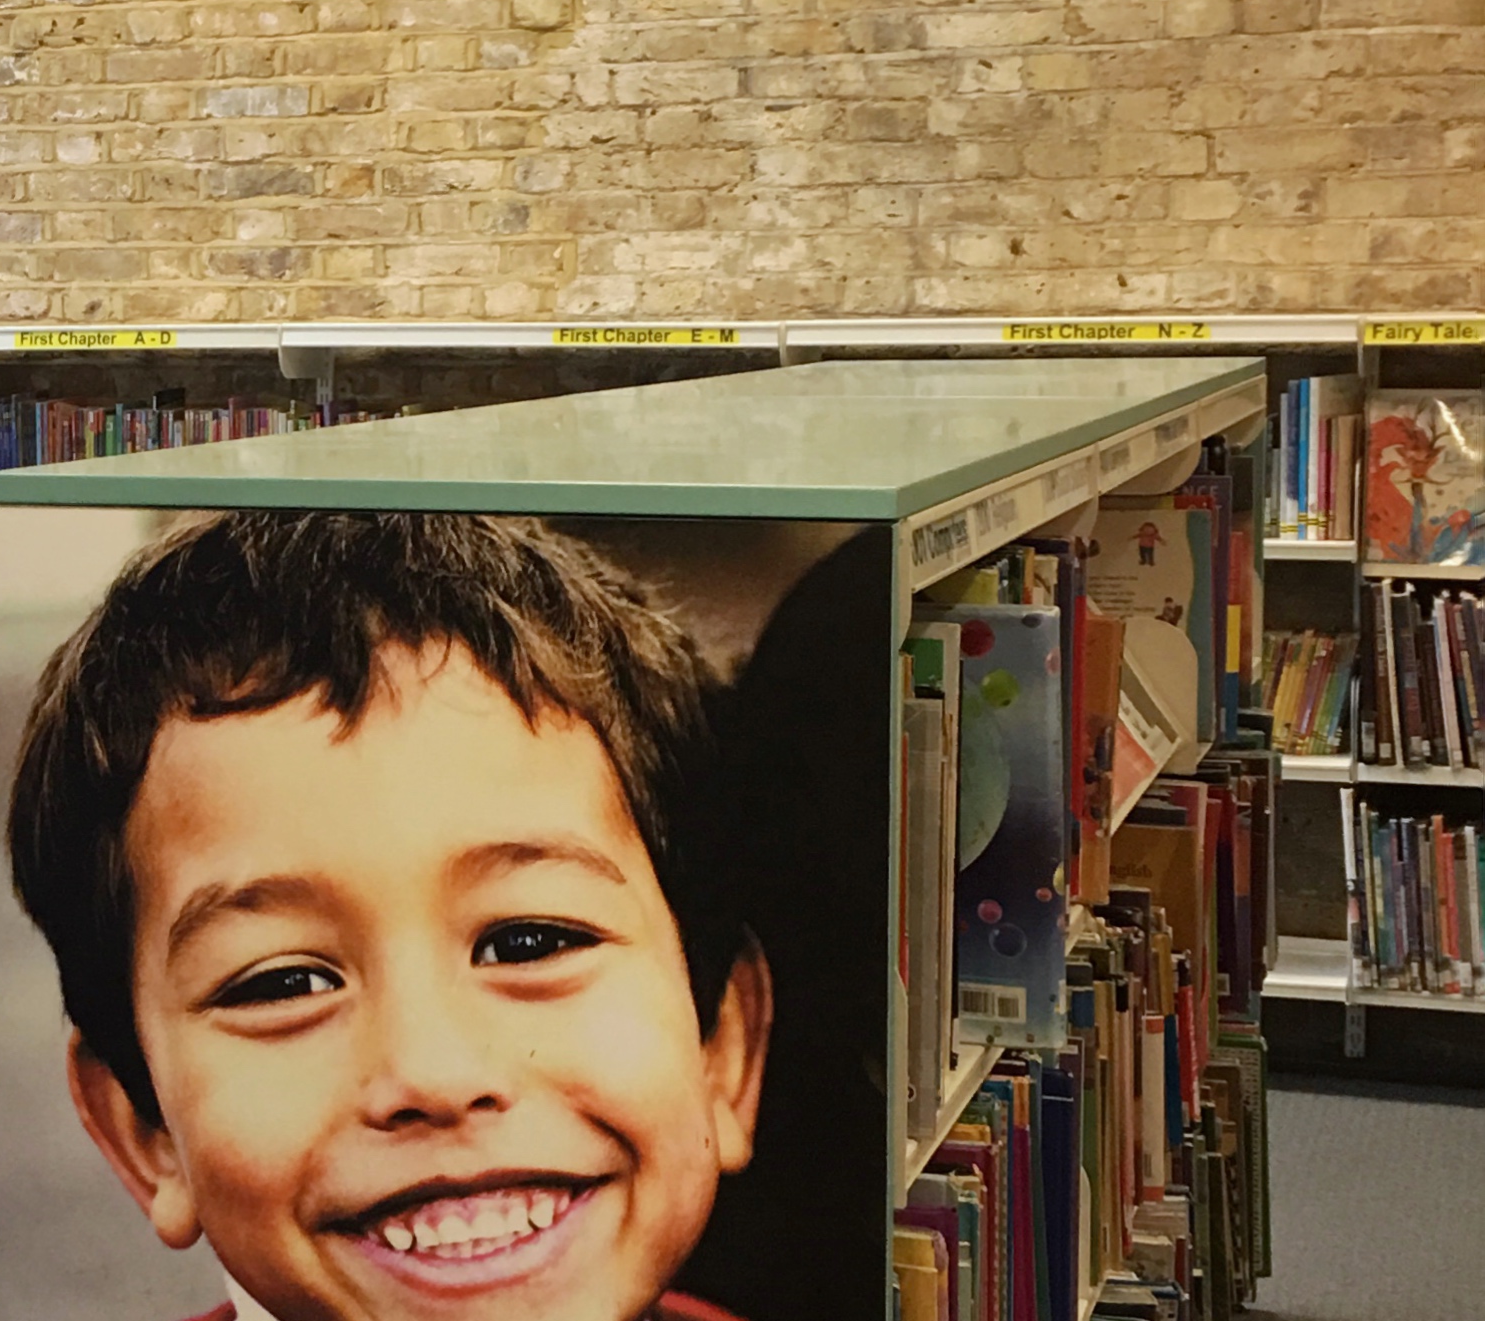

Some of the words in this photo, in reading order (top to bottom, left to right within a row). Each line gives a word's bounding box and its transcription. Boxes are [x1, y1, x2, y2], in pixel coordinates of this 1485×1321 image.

[19, 330, 54, 346] First
[57, 330, 118, 348] Chapter
[133, 330, 146, 345] A
[160, 330, 172, 345] D
[559, 328, 599, 343] First
[602, 328, 672, 344] Chapter
[690, 328, 703, 343] E
[719, 328, 735, 343] M
[1009, 323, 1054, 339] First
[1058, 322, 1136, 341] Chapter
[1157, 322, 1173, 339] N
[1191, 322, 1205, 339] Z
[1372, 322, 1424, 343] Fairy
